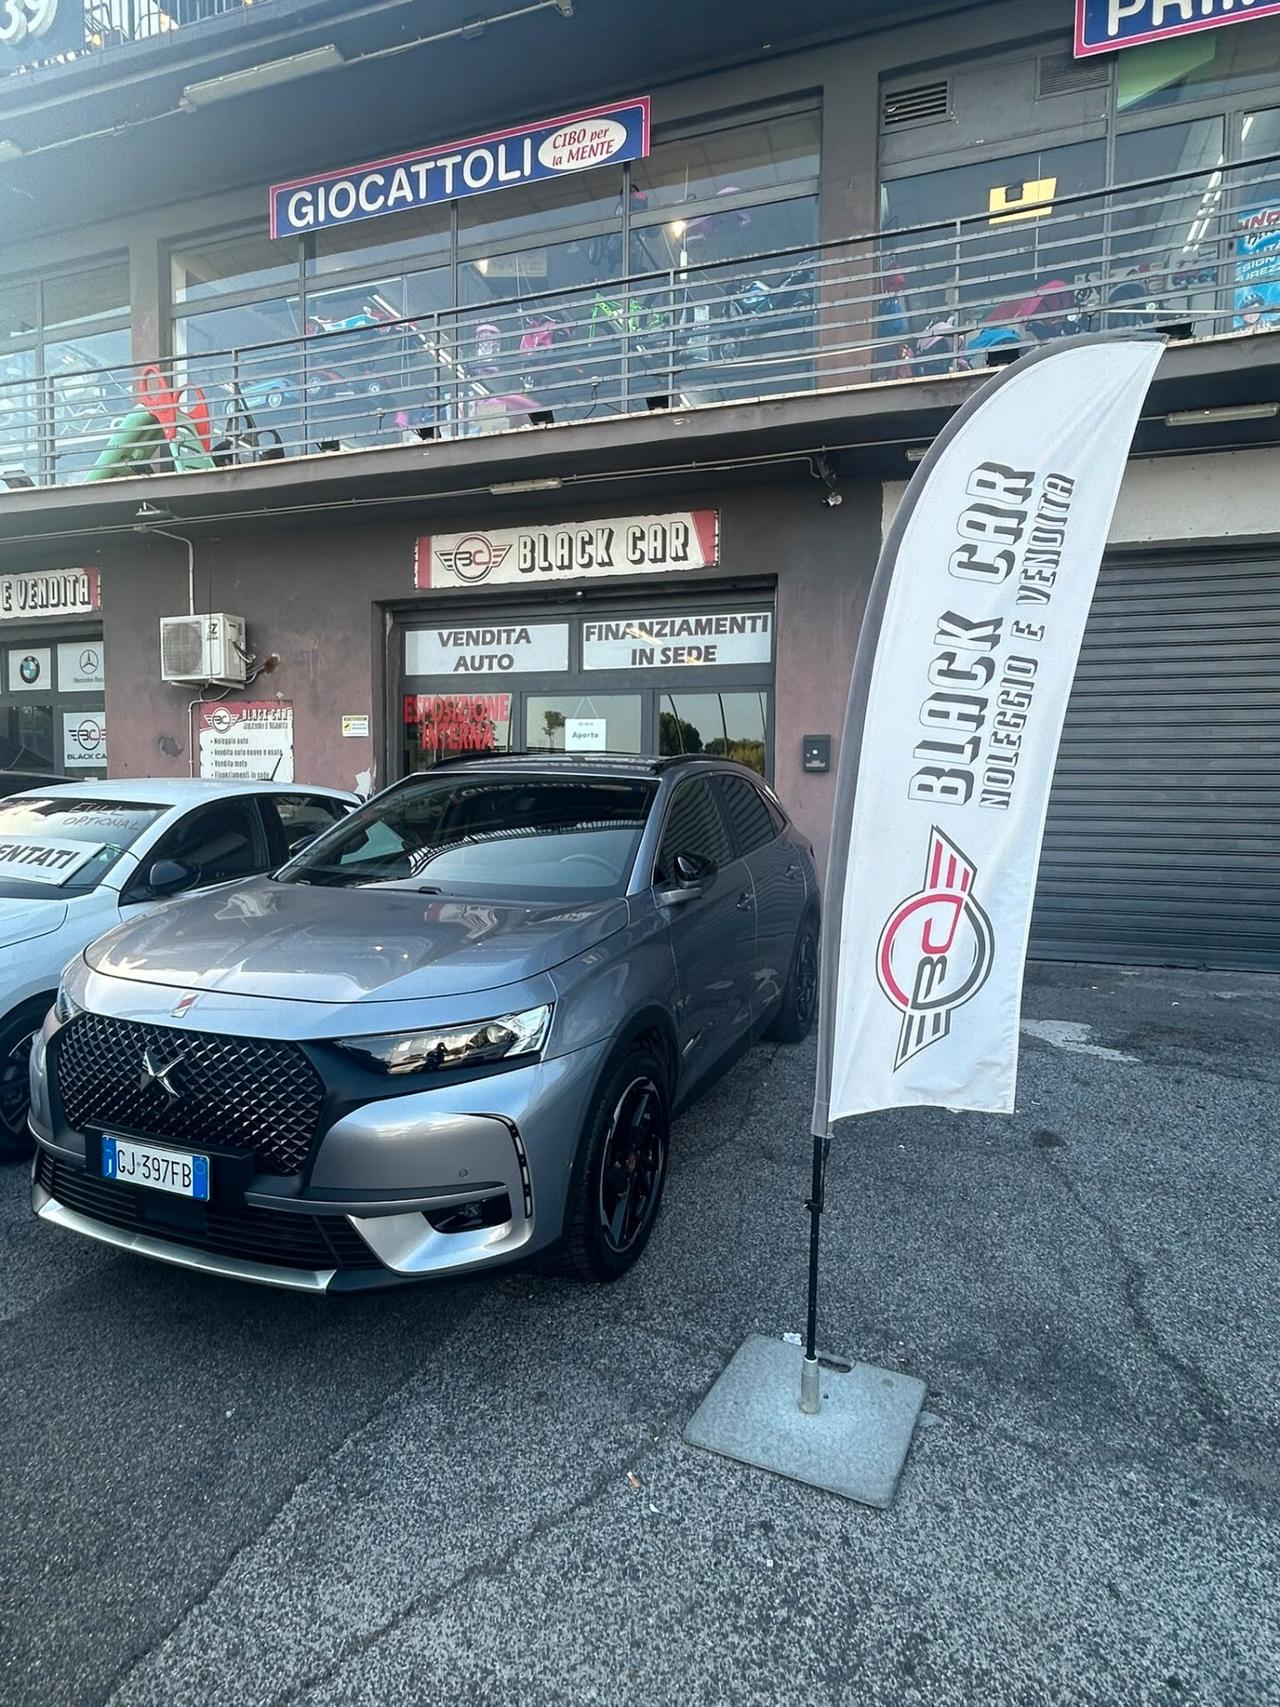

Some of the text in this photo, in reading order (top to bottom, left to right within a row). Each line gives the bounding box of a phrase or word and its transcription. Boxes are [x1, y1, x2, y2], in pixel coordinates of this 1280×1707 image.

[552, 127, 610, 150] CIBO per
[552, 139, 615, 167] la MENTE
[287, 138, 532, 228] GIOCATTOLI
[517, 521, 691, 574] BLACK CAR
[1, 573, 92, 612] E VENDITA
[438, 627, 532, 648] VENDITA
[585, 614, 770, 642] FINANZIAMENTI
[907, 460, 1037, 806] BLACK CAR
[979, 472, 1076, 811] NOLEGGIO E VENDITA
[453, 653, 515, 672] AUTO
[631, 645, 718, 666] IN SEDE
[402, 694, 510, 723] ESPOSIZIONE
[421, 720, 495, 751] INTERNA
[62, 815, 140, 831] OPTIONAL
